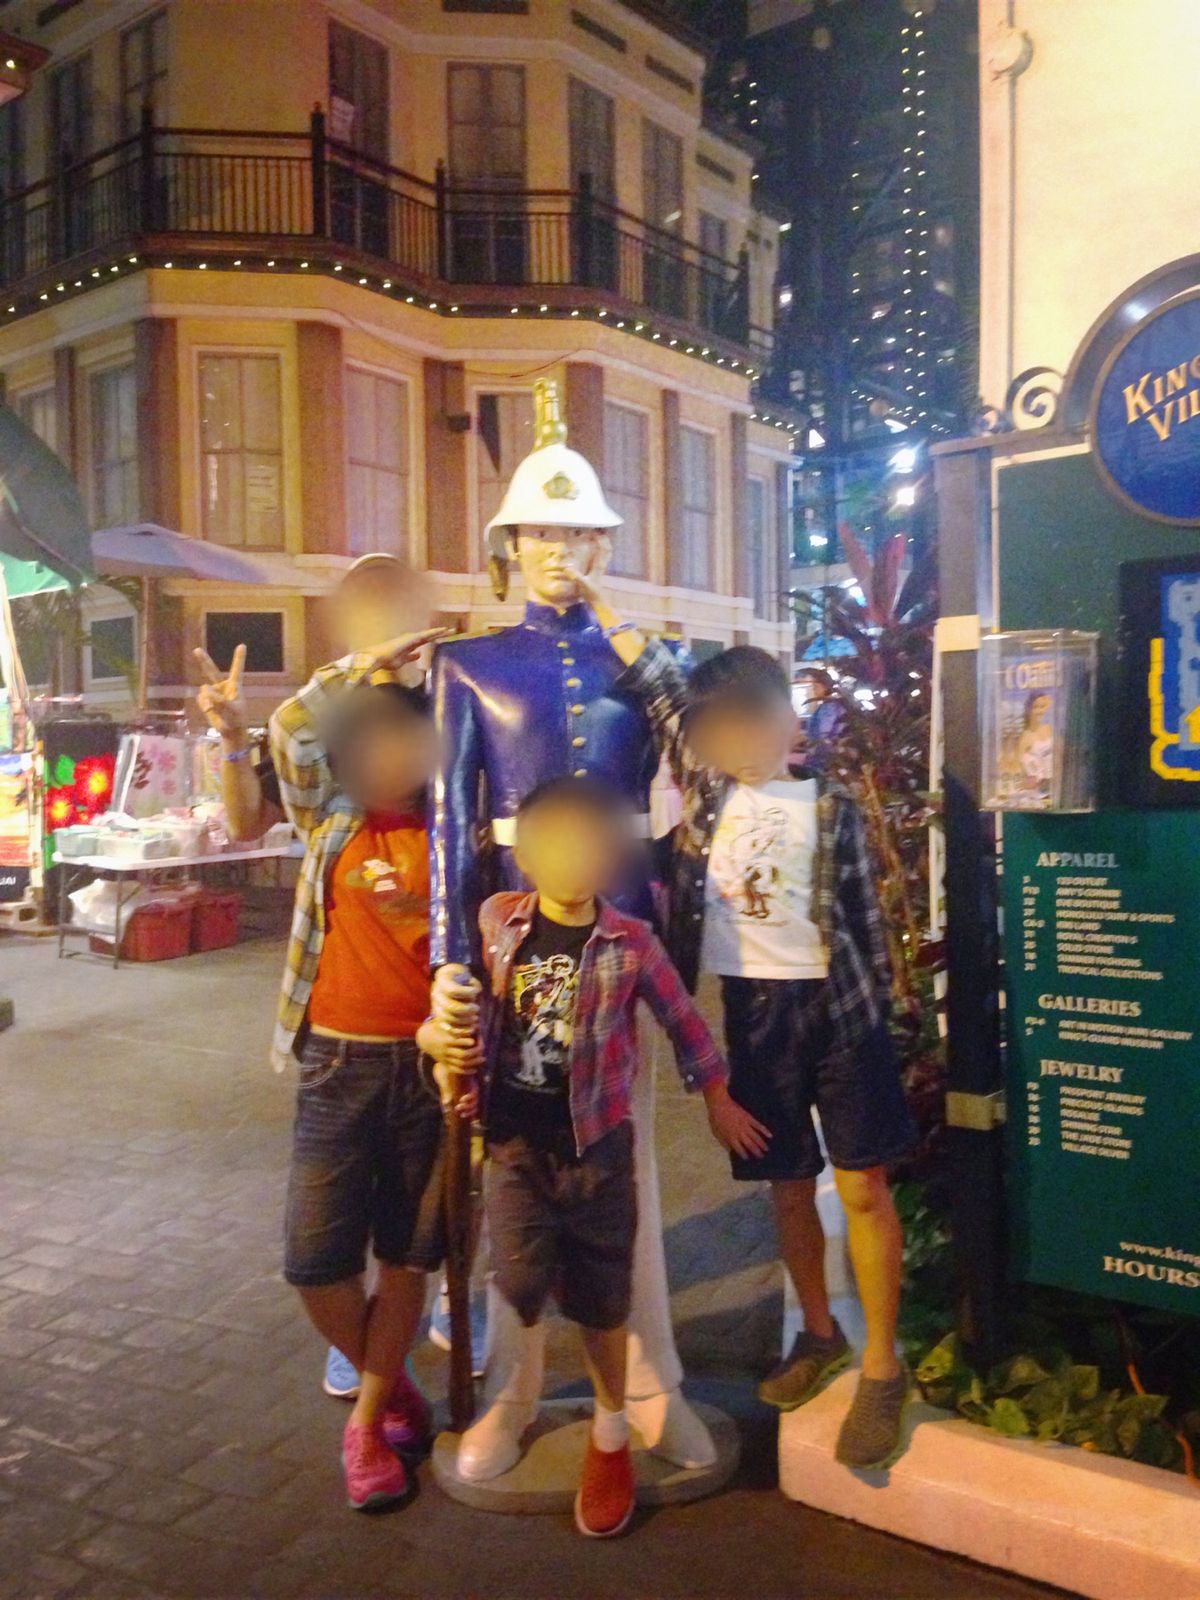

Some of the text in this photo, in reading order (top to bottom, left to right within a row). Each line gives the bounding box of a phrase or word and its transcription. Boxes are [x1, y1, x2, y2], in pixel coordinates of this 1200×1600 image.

[1036, 852, 1120, 868] APPAREL
[1038, 993, 1142, 1017] GALLERIES
[1040, 1059, 1124, 1083] JEWELRY
[1103, 1256, 1200, 1288] HOURS
